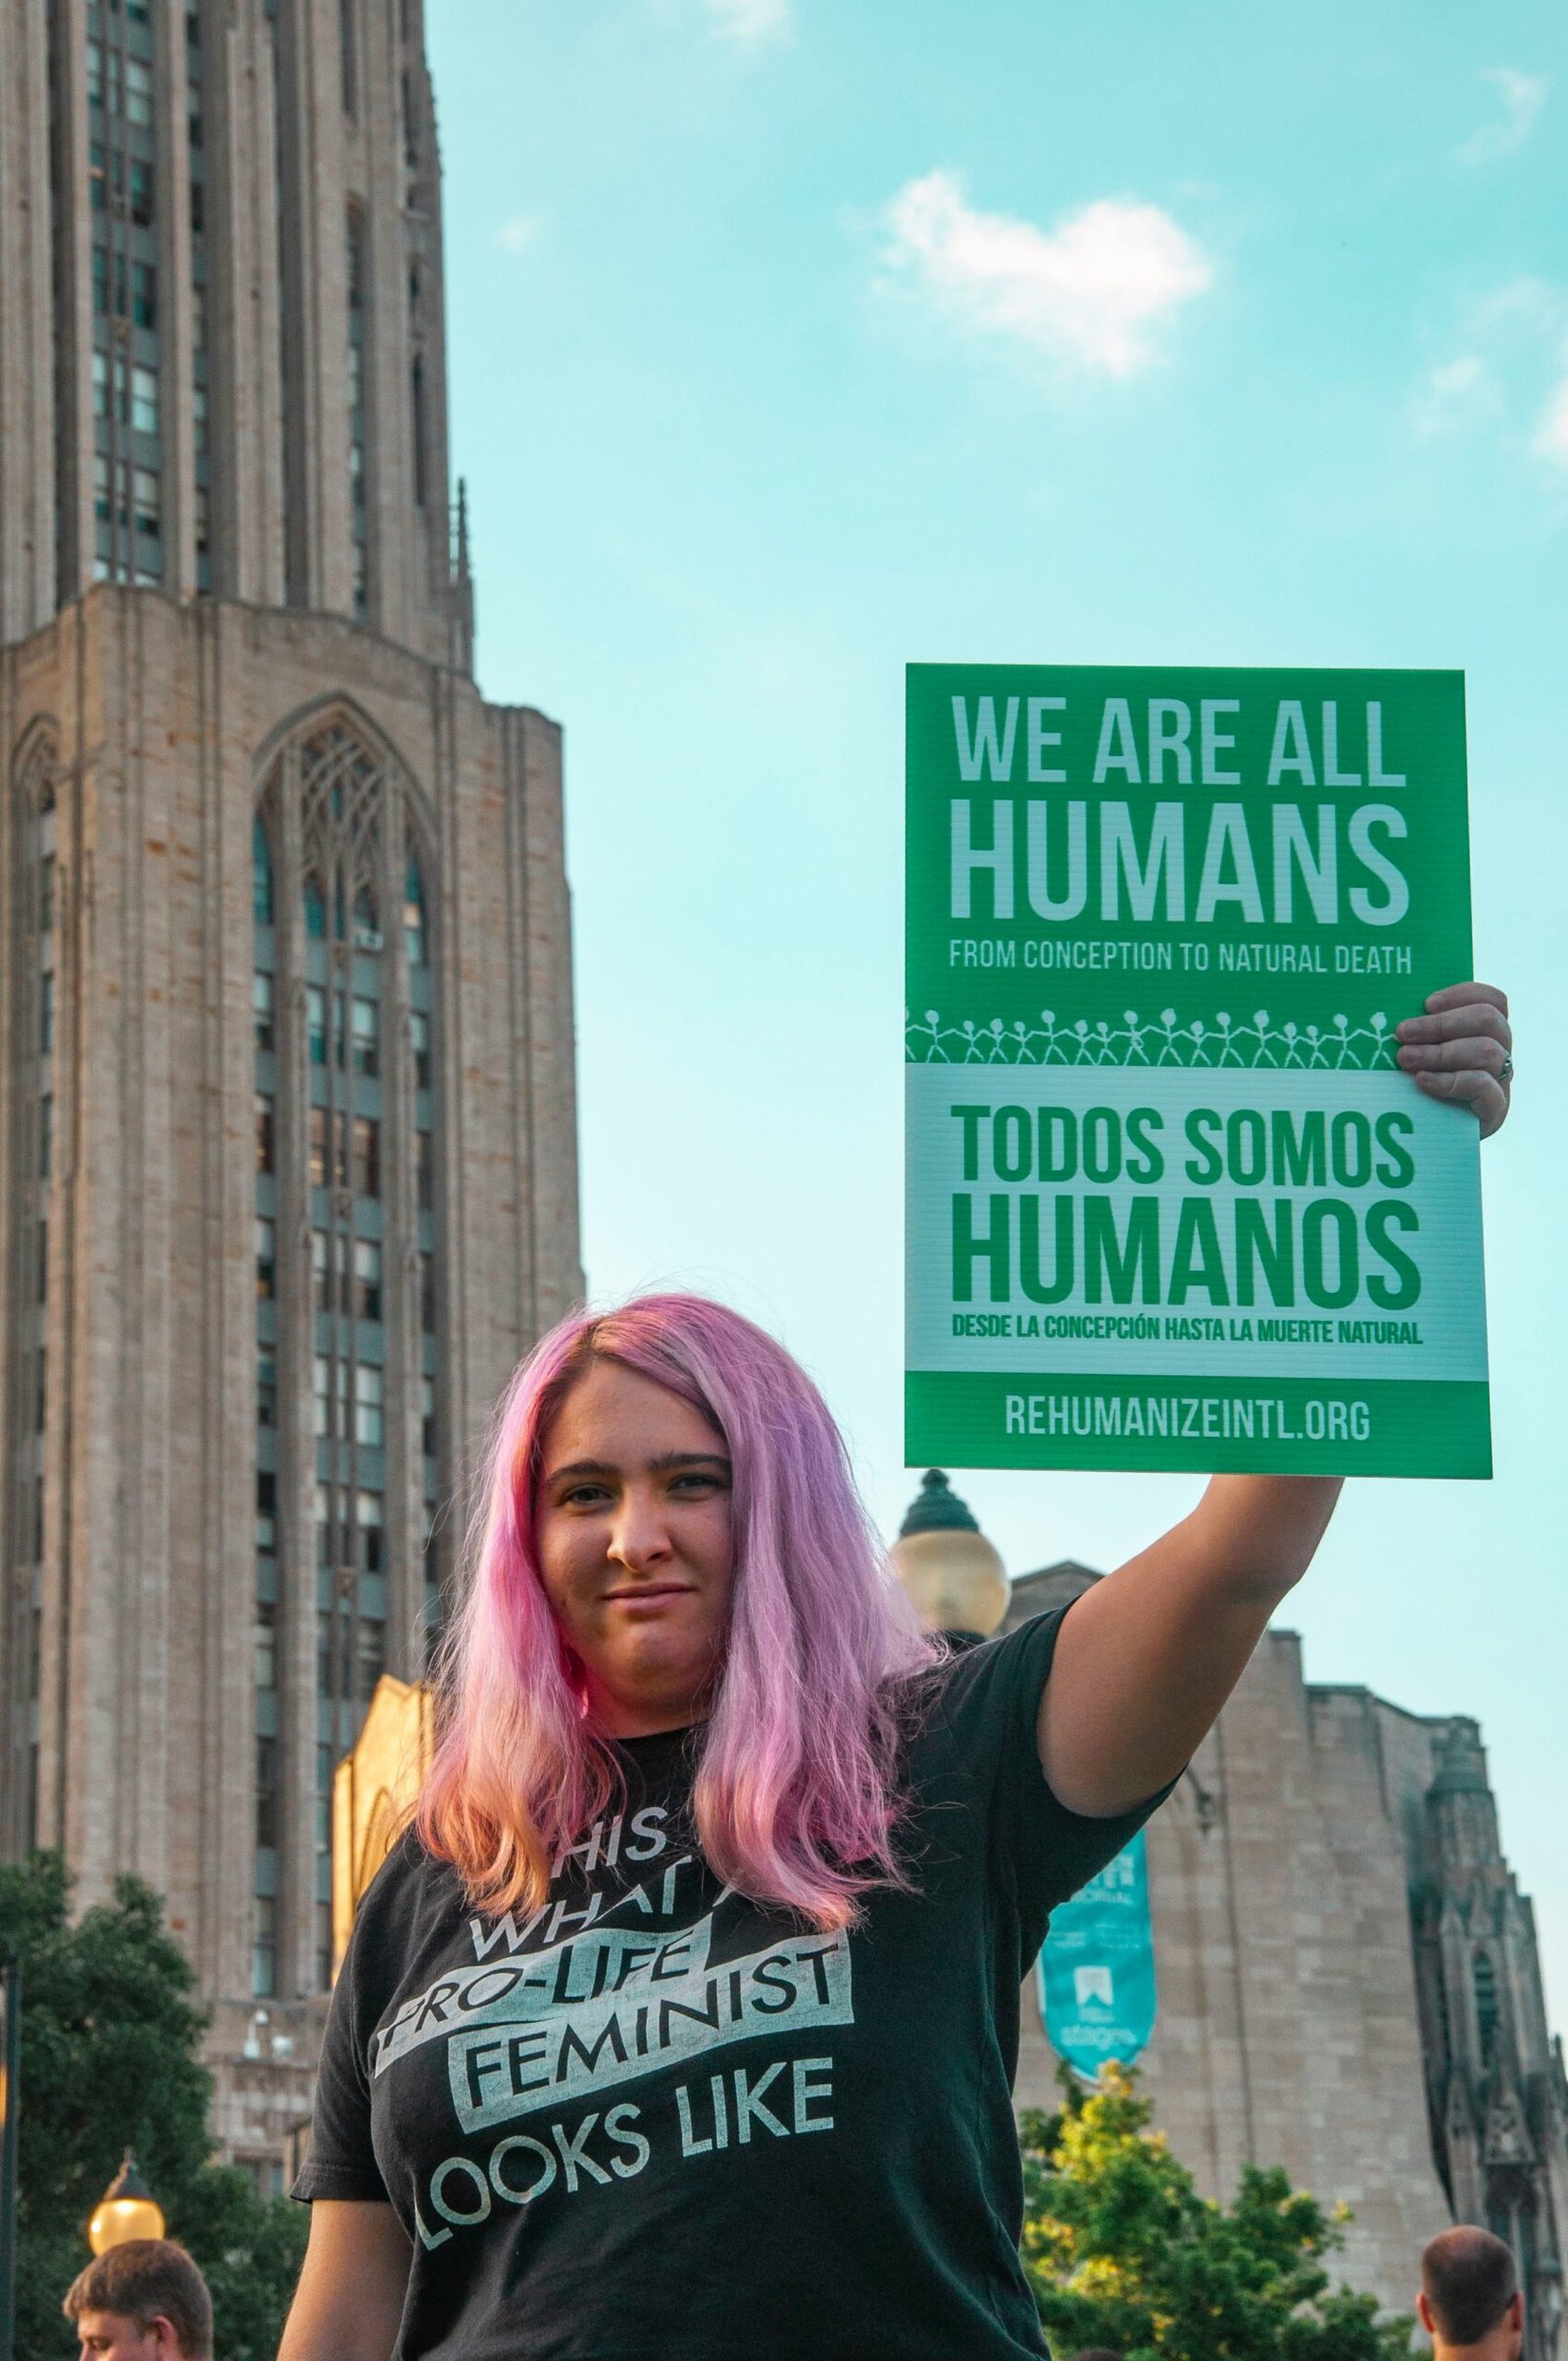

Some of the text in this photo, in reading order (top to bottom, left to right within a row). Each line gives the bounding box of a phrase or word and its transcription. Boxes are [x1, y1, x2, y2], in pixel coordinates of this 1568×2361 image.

[952, 696, 1405, 786] WE ARE ALL
[951, 800, 1408, 925] HUMANS
[951, 940, 1411, 973] FROM CONCEPTION TO NATURAL DEATH
[951, 1106, 1414, 1189] TODOS SOMOS
[953, 1194, 1421, 1310] HUMANOS
[953, 1313, 1423, 1345] DESDE LA CONCEPCIÓN HASTA LA MUERTE NATURAL
[1006, 1396, 1369, 1440] REHUMANIZEINTL.ORG
[551, 1806, 668, 1879] HIS
[382, 1927, 696, 2051] PRO-LIFE
[466, 1943, 839, 2109] FEMINIST
[414, 2057, 834, 2252] LOOKS LIKE
